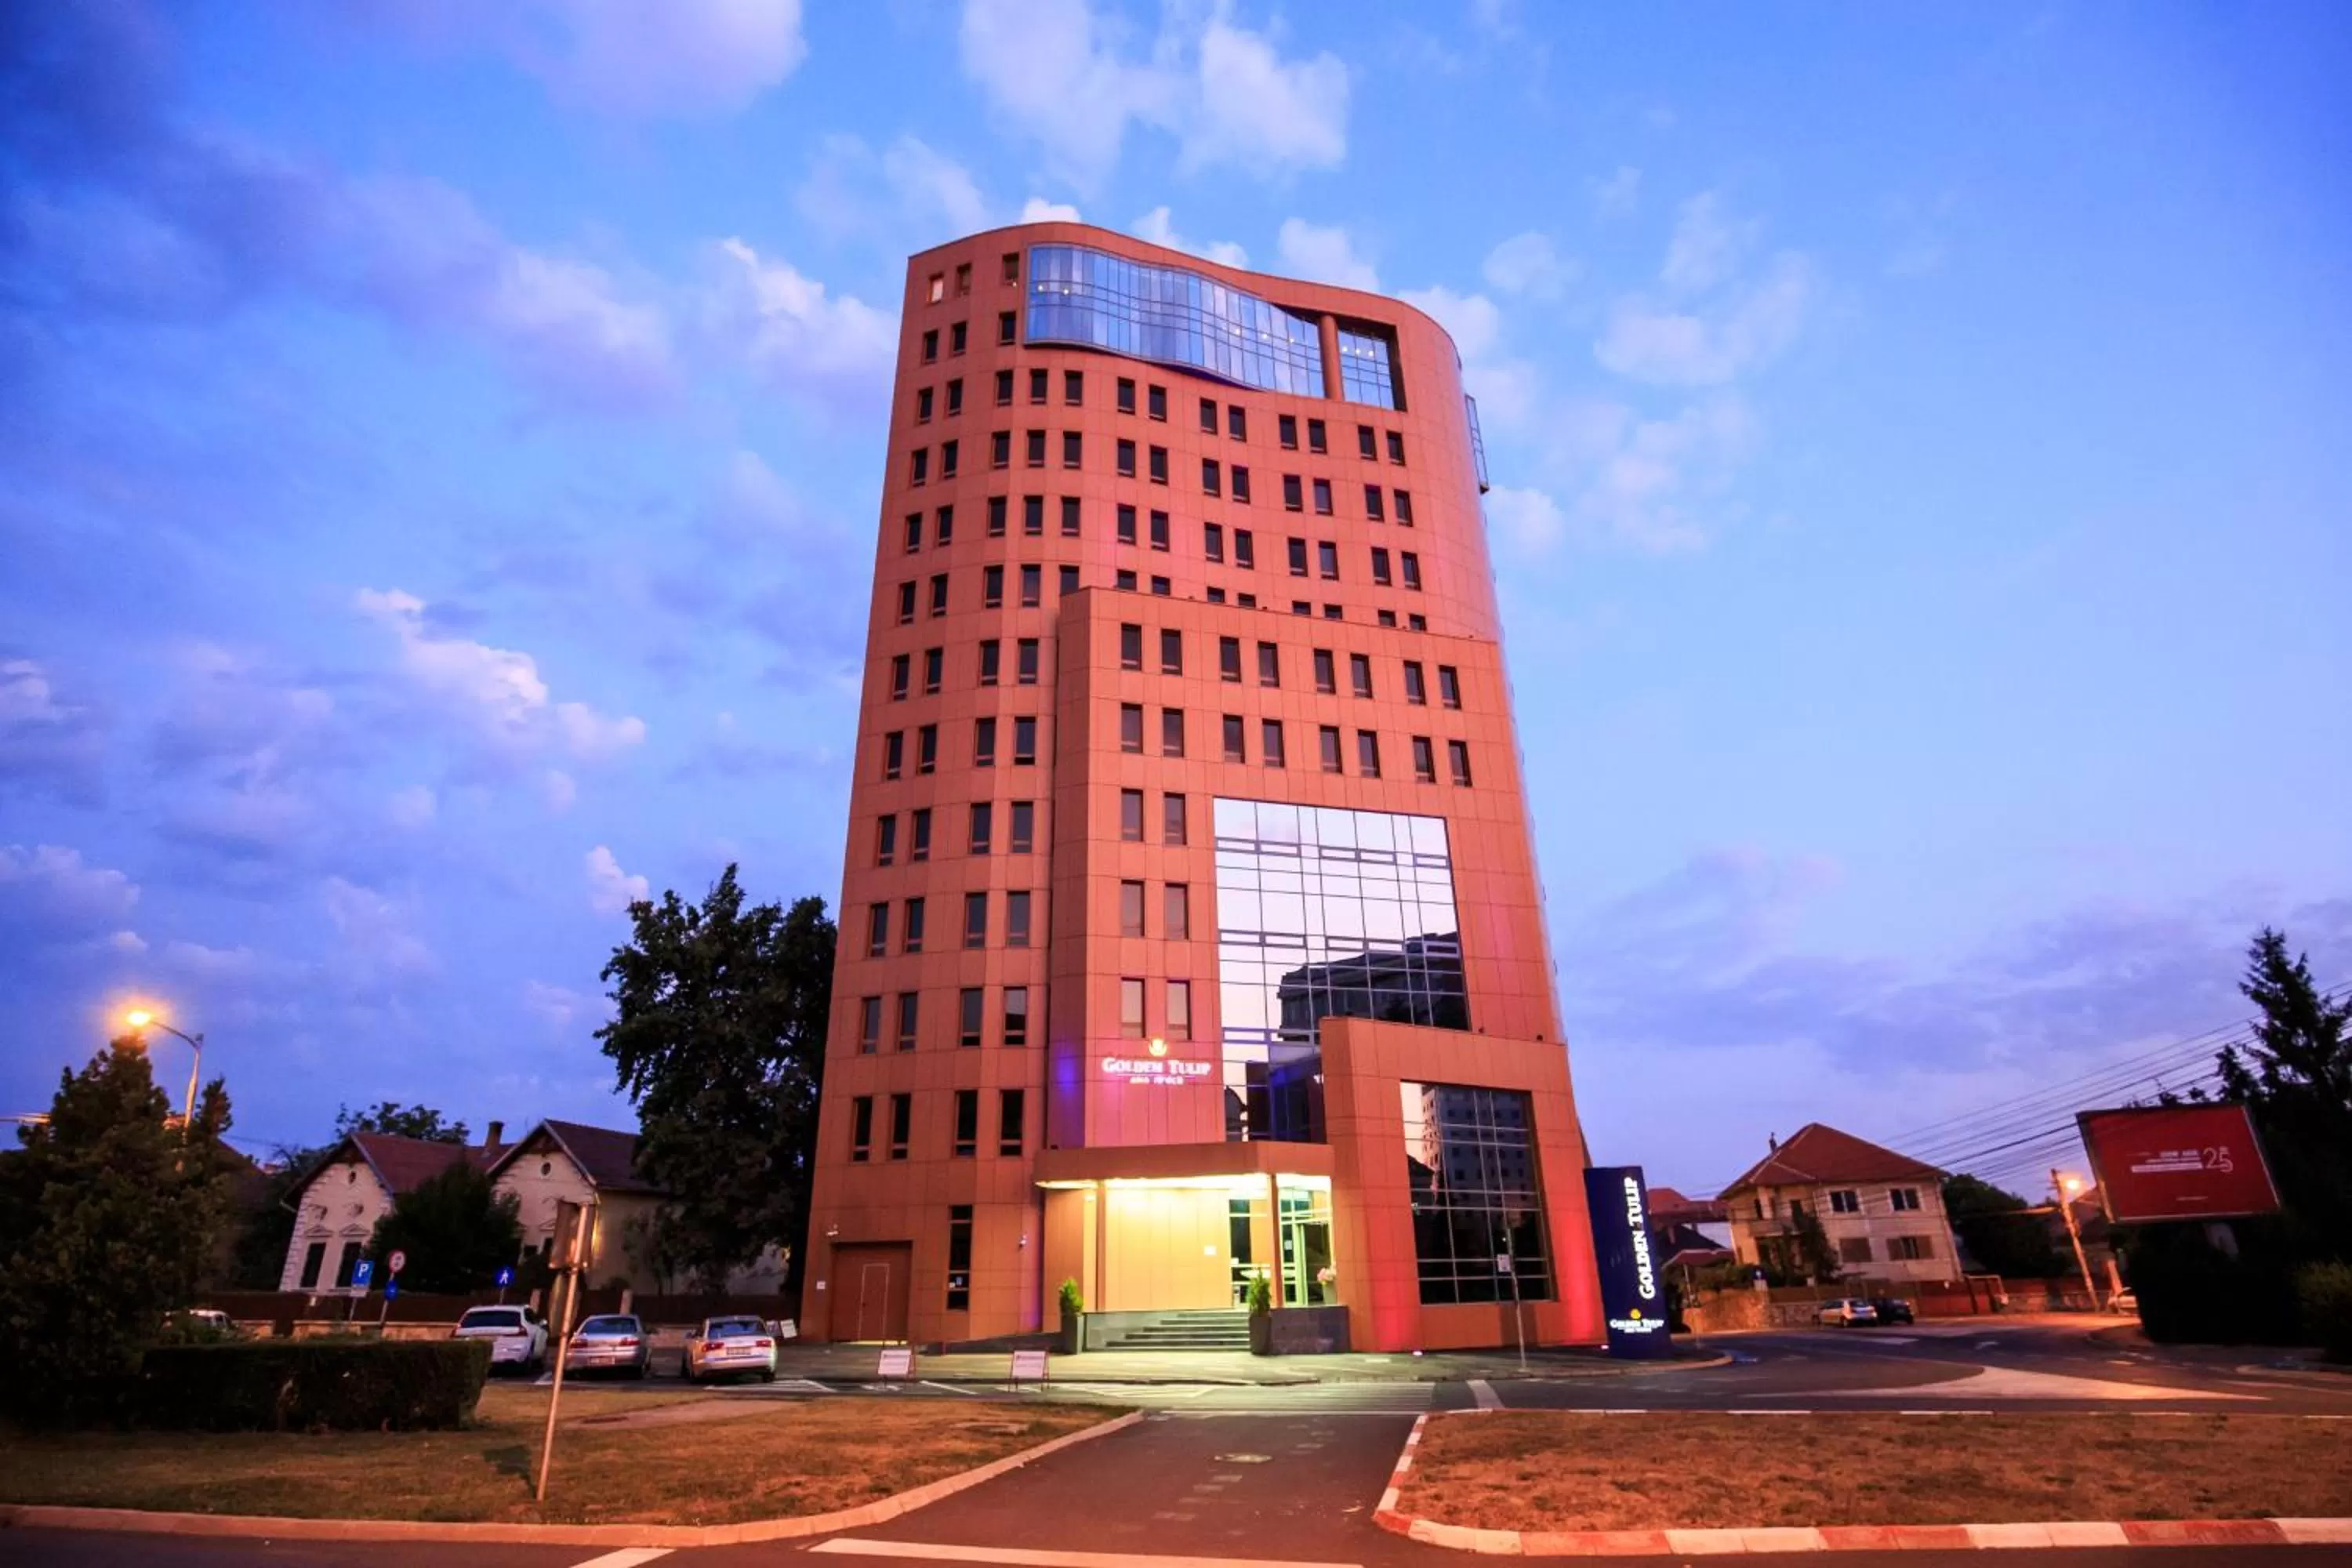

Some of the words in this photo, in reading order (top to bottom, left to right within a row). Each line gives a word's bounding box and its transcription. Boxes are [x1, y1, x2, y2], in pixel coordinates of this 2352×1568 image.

[2204, 1146, 2233, 1173] 25
[1624, 1177, 1644, 1227] TULIP
[358, 1263, 369, 1278] P
[1632, 1230, 1656, 1299] GOLDEN
